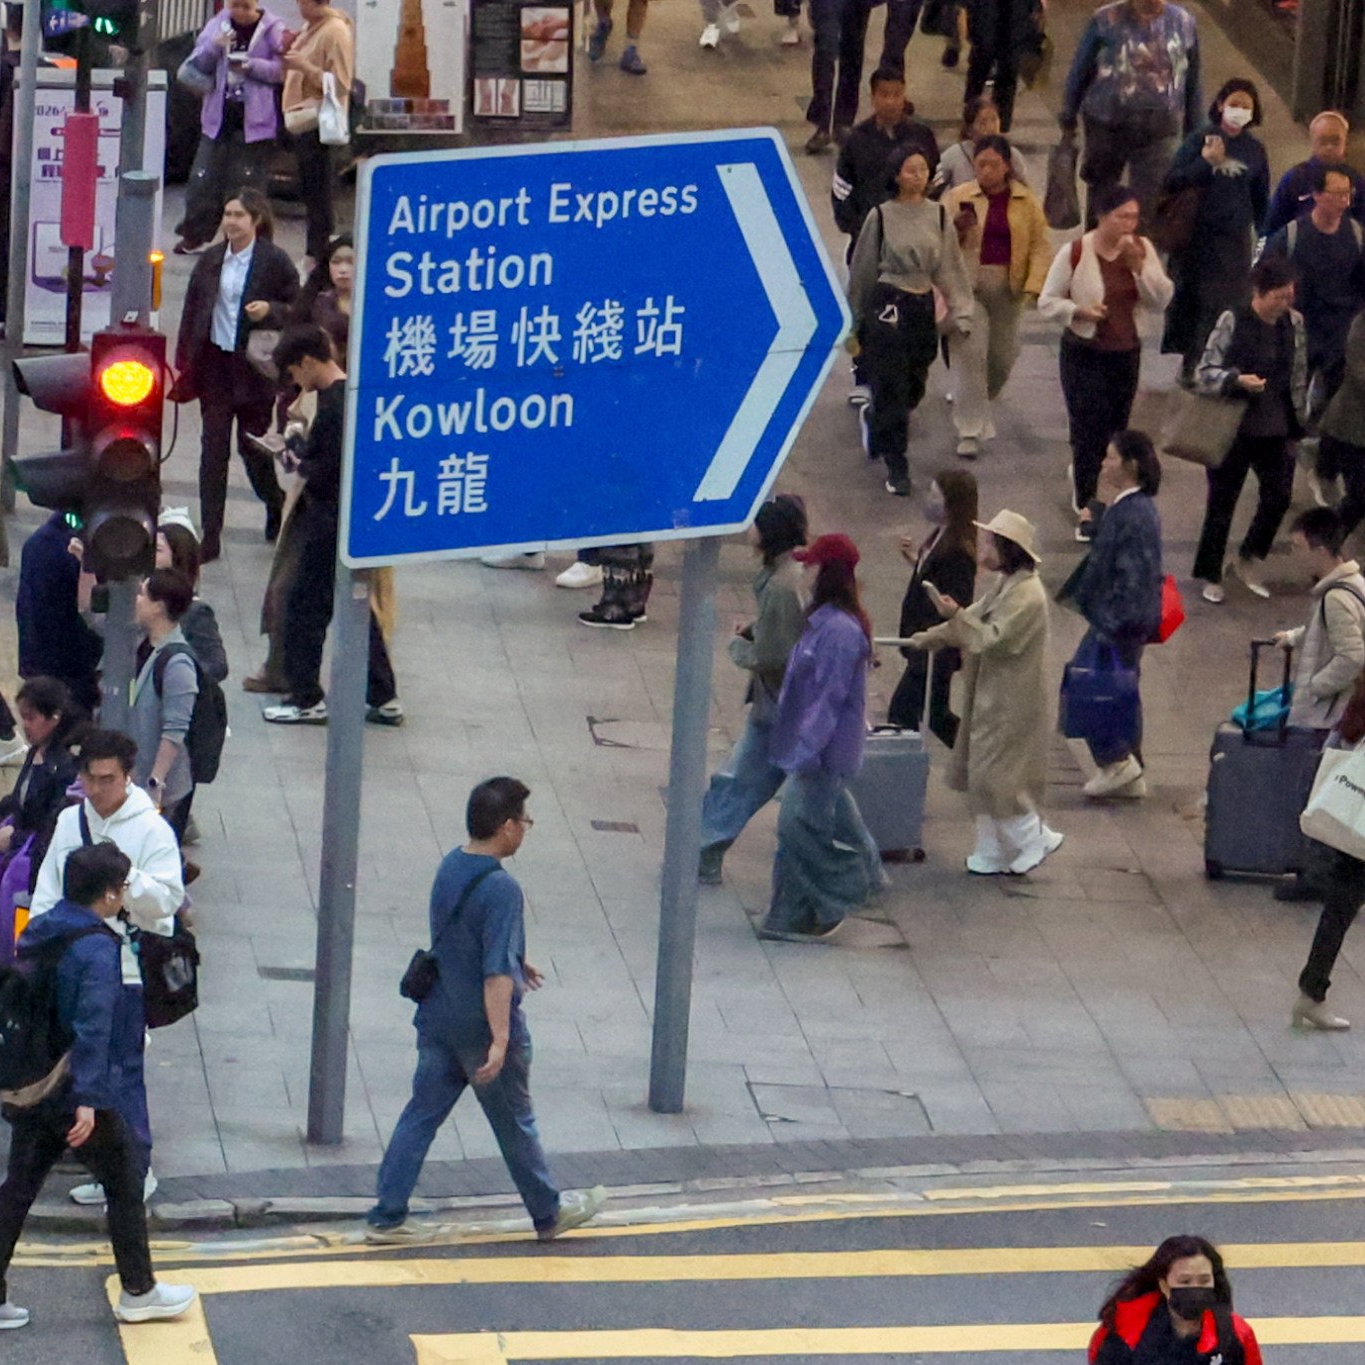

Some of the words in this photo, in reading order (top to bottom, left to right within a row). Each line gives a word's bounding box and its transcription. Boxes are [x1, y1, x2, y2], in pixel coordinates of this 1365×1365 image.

[387, 186, 533, 239] Airport
[548, 182, 699, 229] Express
[383, 246, 554, 299] Station
[382, 295, 686, 379] 機場快綫站
[373, 387, 575, 442] Kowloon
[372, 451, 491, 523] 九龍
